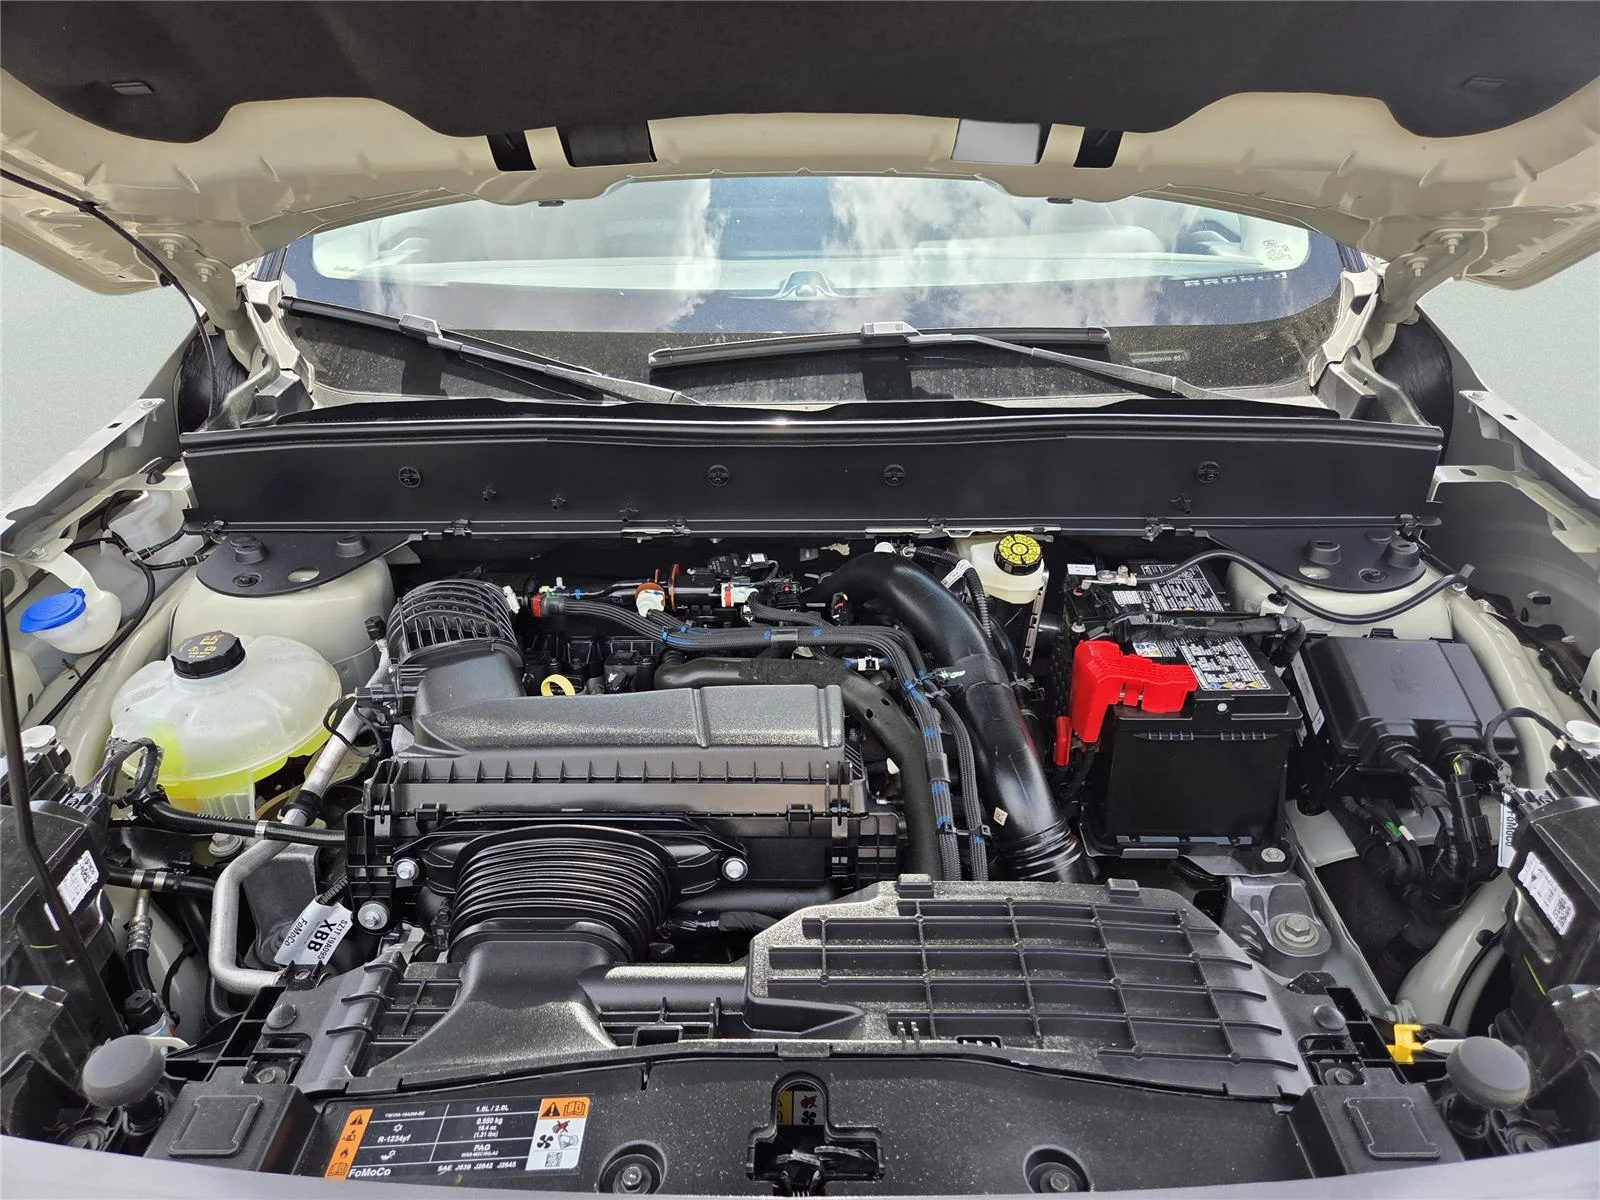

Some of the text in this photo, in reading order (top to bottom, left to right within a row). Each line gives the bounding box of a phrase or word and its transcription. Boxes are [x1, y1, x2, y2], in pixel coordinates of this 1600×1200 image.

[284, 917, 308, 946] FoMoCo
[307, 918, 337, 952] XBB
[317, 936, 337, 961] 19A095
[494, 1117, 503, 1125] kg
[377, 1134, 412, 1143] R-1234yf
[473, 1144, 491, 1152] PAG
[347, 1166, 392, 1178] FoMoCo
